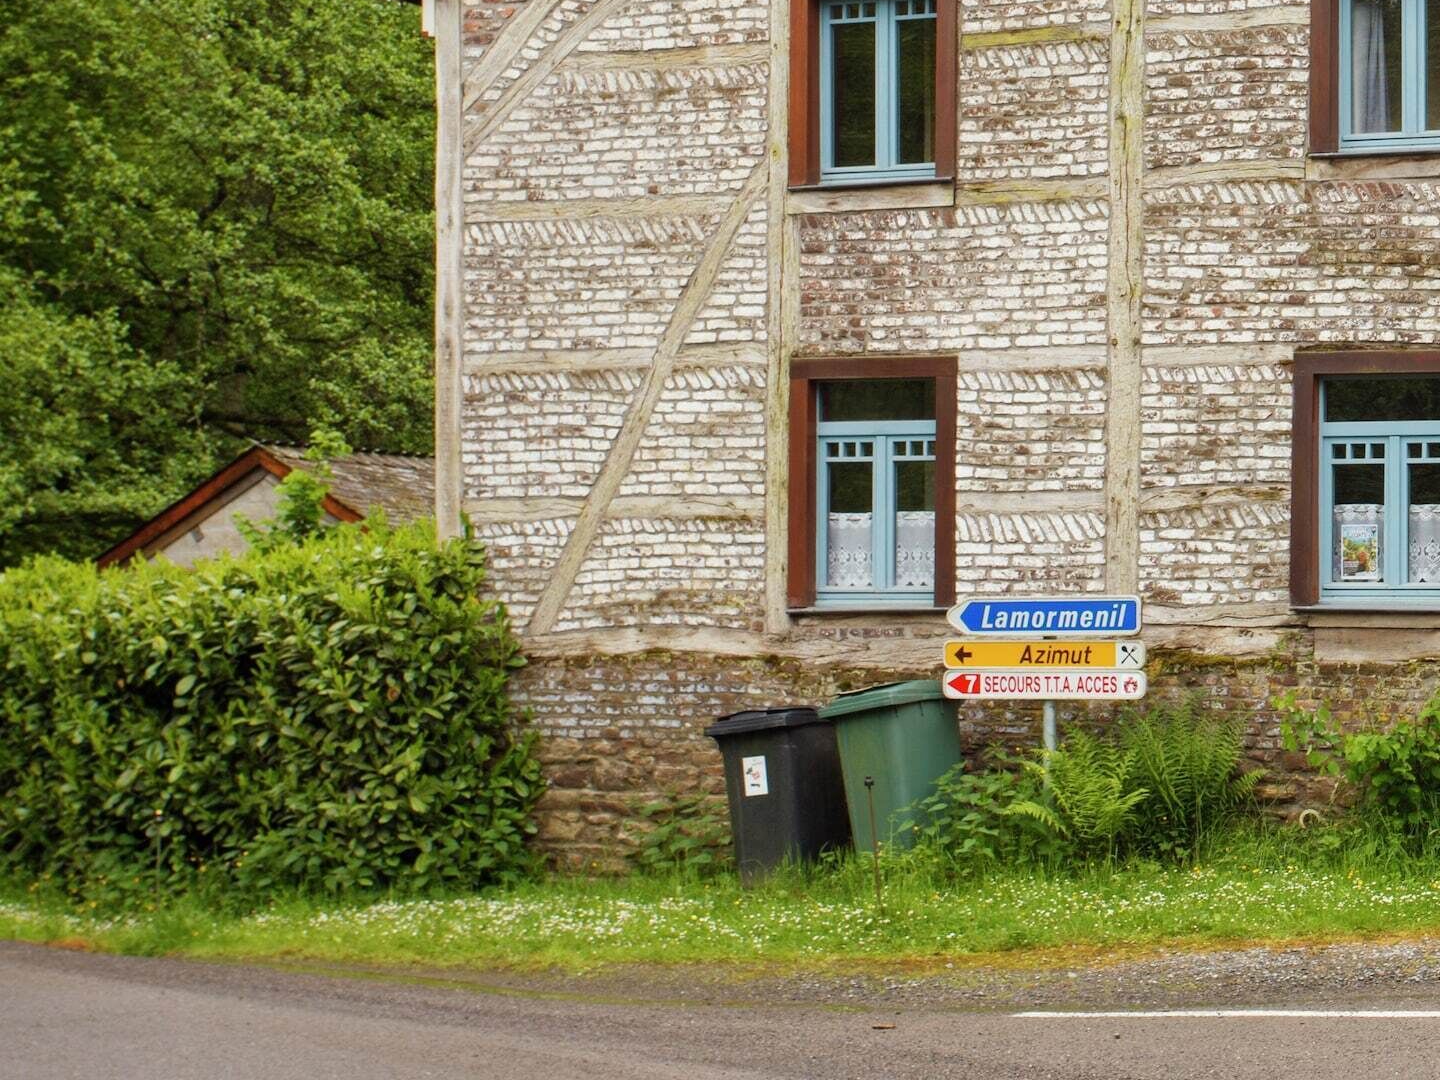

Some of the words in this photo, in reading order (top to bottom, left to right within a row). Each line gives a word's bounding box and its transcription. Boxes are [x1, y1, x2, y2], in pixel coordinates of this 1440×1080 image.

[981, 603, 1127, 629] Lamormenil
[1019, 645, 1092, 664] Azimut
[965, 675, 978, 693] 7
[984, 676, 1041, 694] SECOURS
[1044, 676, 1074, 694] T.T.A.
[1076, 675, 1118, 693] ACCES
